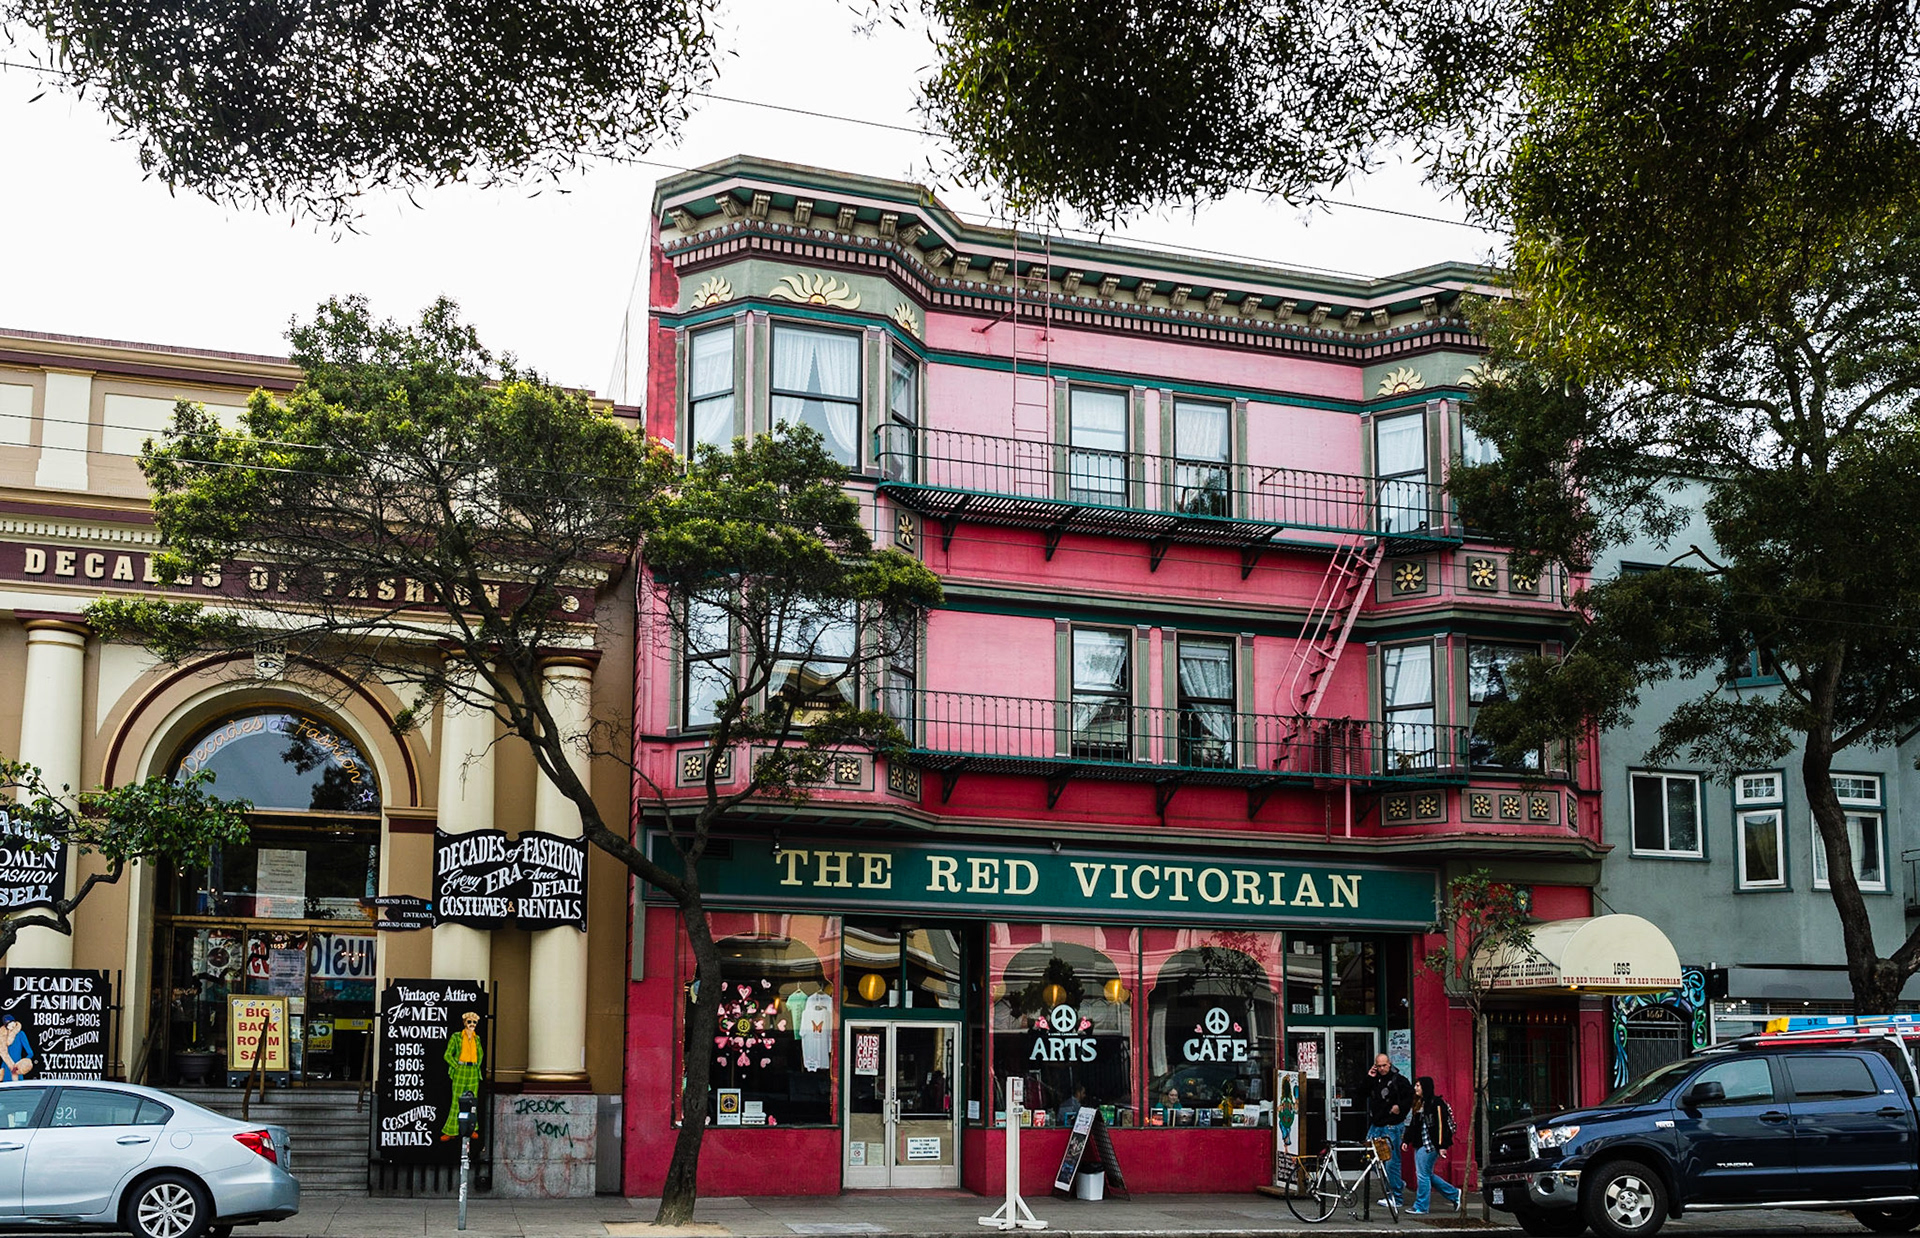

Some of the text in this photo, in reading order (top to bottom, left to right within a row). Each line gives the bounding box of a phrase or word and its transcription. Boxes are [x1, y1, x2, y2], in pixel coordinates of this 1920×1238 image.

[180, 714, 362, 784] Decades of Fashion
[438, 836, 585, 882] DECADES of FASHION
[440, 869, 482, 895] Every
[484, 863, 523, 895] ERA
[776, 850, 1362, 908] THE RED VICTORIAN
[531, 879, 582, 897] DETAIL
[439, 896, 581, 919] COSTUMES & RENTALS
[1613, 962, 1631, 975] 1665
[13, 976, 93, 992] DECADES
[1563, 976, 1575, 984] THE
[1576, 976, 1588, 984] RED
[1625, 977, 1637, 985] THE
[1638, 977, 1649, 985] RED
[0, 992, 102, 1011] of FASHION
[397, 985, 477, 1007] Vintage Attire
[245, 1008, 270, 1017] BIG
[387, 1003, 448, 1024] For MEN
[39, 1027, 72, 1046] 100 YEARS
[387, 1025, 448, 1039] & WOMEN
[64, 1031, 100, 1052] FASHION
[237, 1036, 280, 1046] ROM
[857, 1035, 878, 1047] ARTS
[1298, 1042, 1317, 1053] ARTS
[240, 1050, 277, 1060] SAE
[395, 1043, 425, 1056] 1950's
[857, 1047, 878, 1058] CAFE
[1029, 1037, 1097, 1062] ARTS
[1183, 1038, 1248, 1062] CAFE
[41, 1053, 104, 1070] VICTORIAN
[394, 1058, 425, 1071] 1960's
[857, 1058, 878, 1069] OPEN
[1298, 1053, 1317, 1062] CAFE
[1299, 1063, 1317, 1071] OPEN
[394, 1074, 424, 1087] 1970's
[394, 1089, 424, 1101] 1980's
[382, 1105, 437, 1131] COSTUMES
[414, 1120, 428, 1131] &
[381, 1131, 433, 1147] RENTALS
